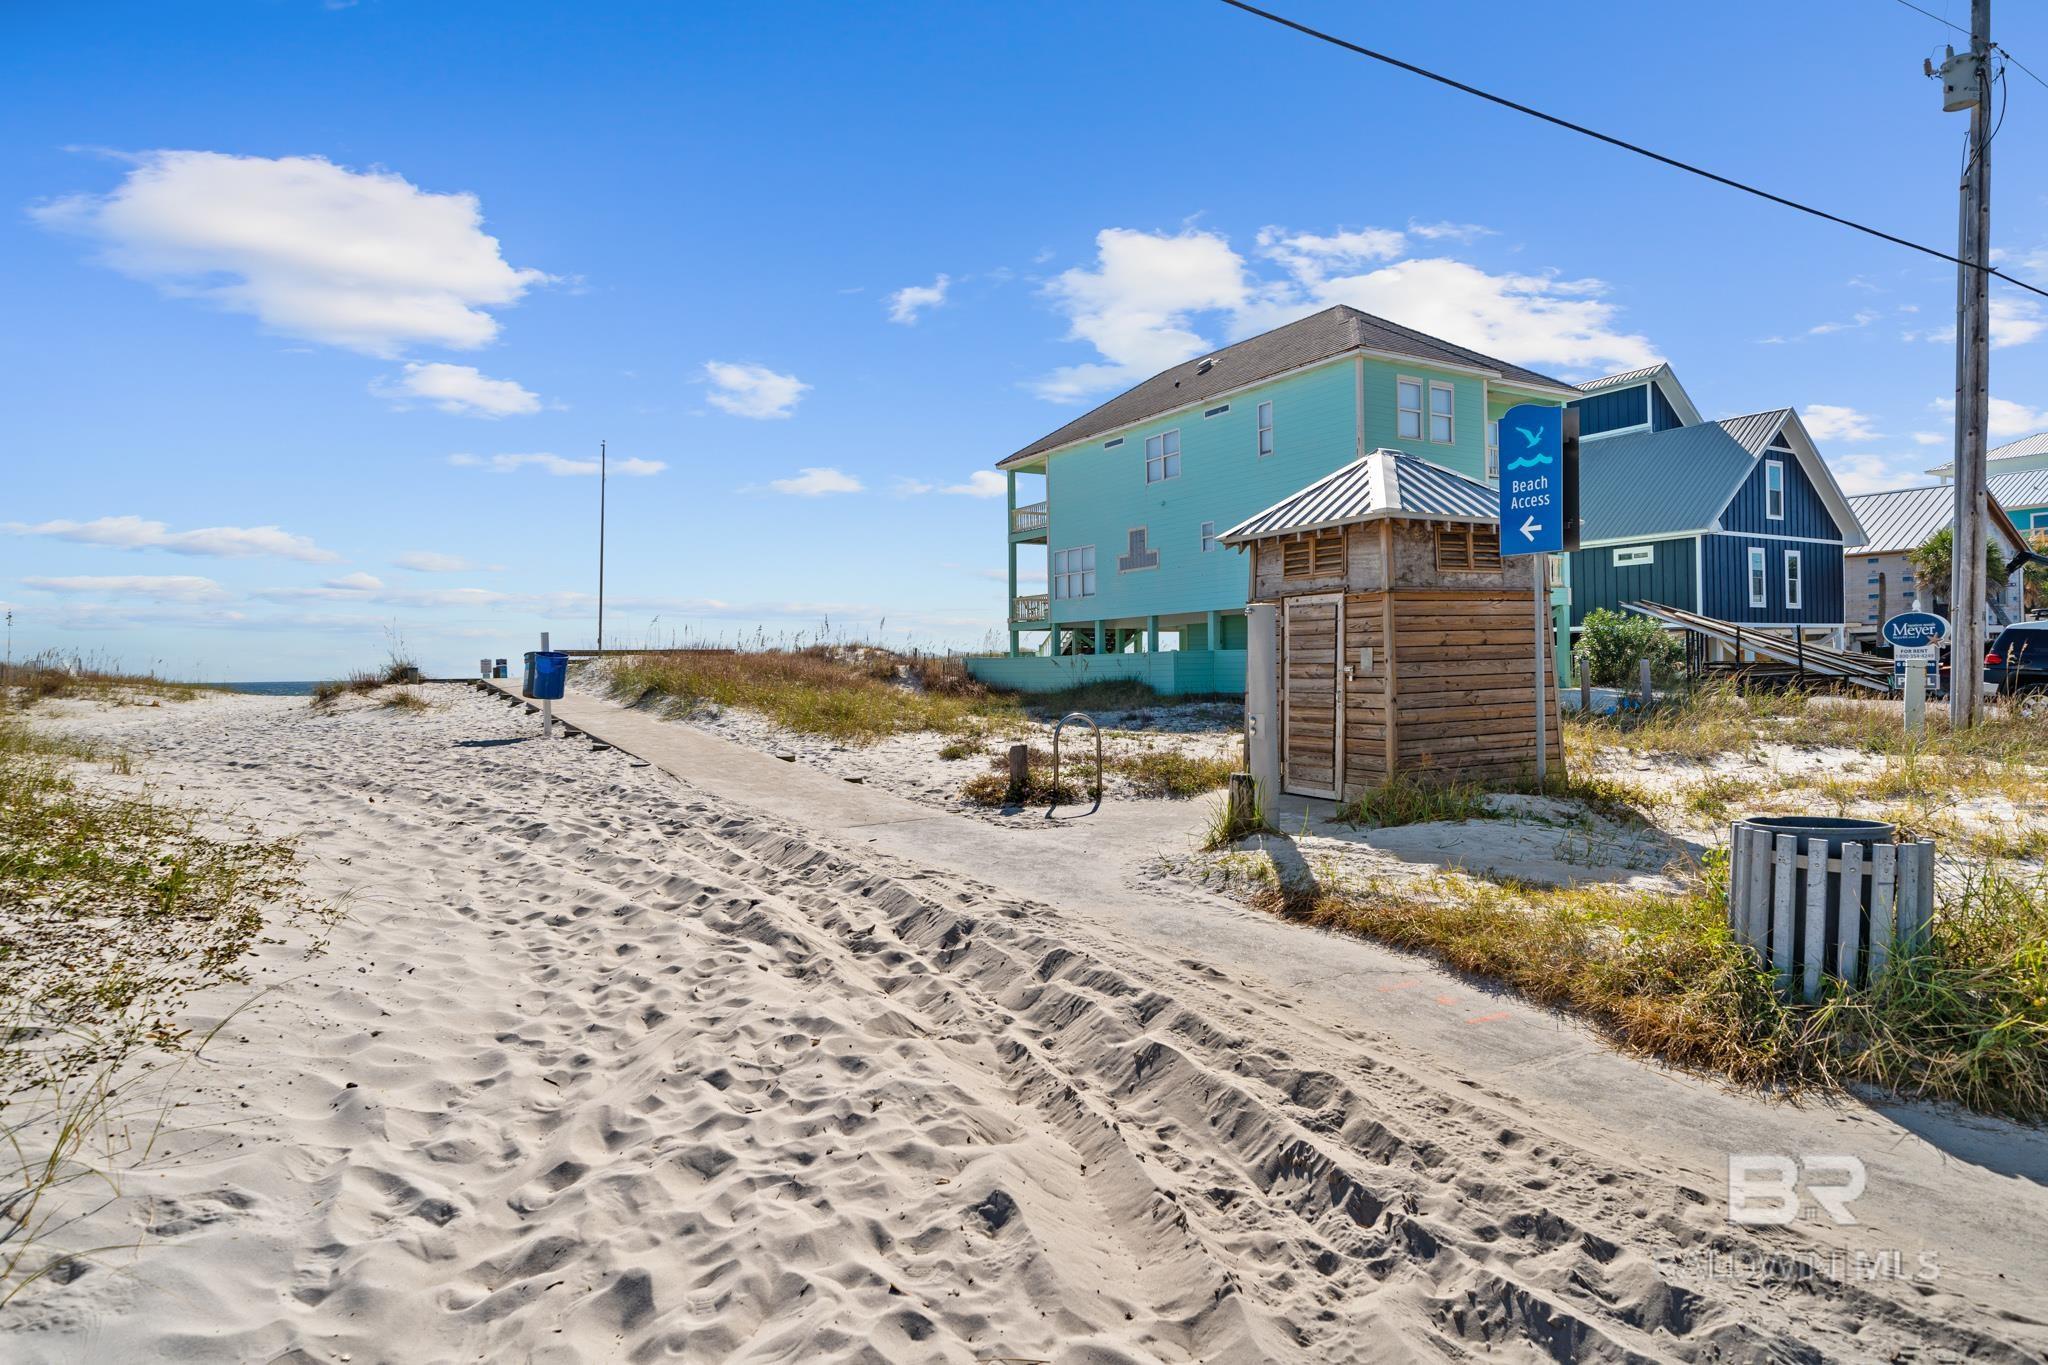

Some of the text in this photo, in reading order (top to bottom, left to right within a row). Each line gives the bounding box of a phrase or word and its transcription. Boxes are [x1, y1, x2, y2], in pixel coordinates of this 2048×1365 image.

[1512, 475, 1548, 493] Beach
[1511, 494, 1550, 510] Access
[1892, 623, 1936, 638] Meyer
[1897, 677, 1935, 686] PL
